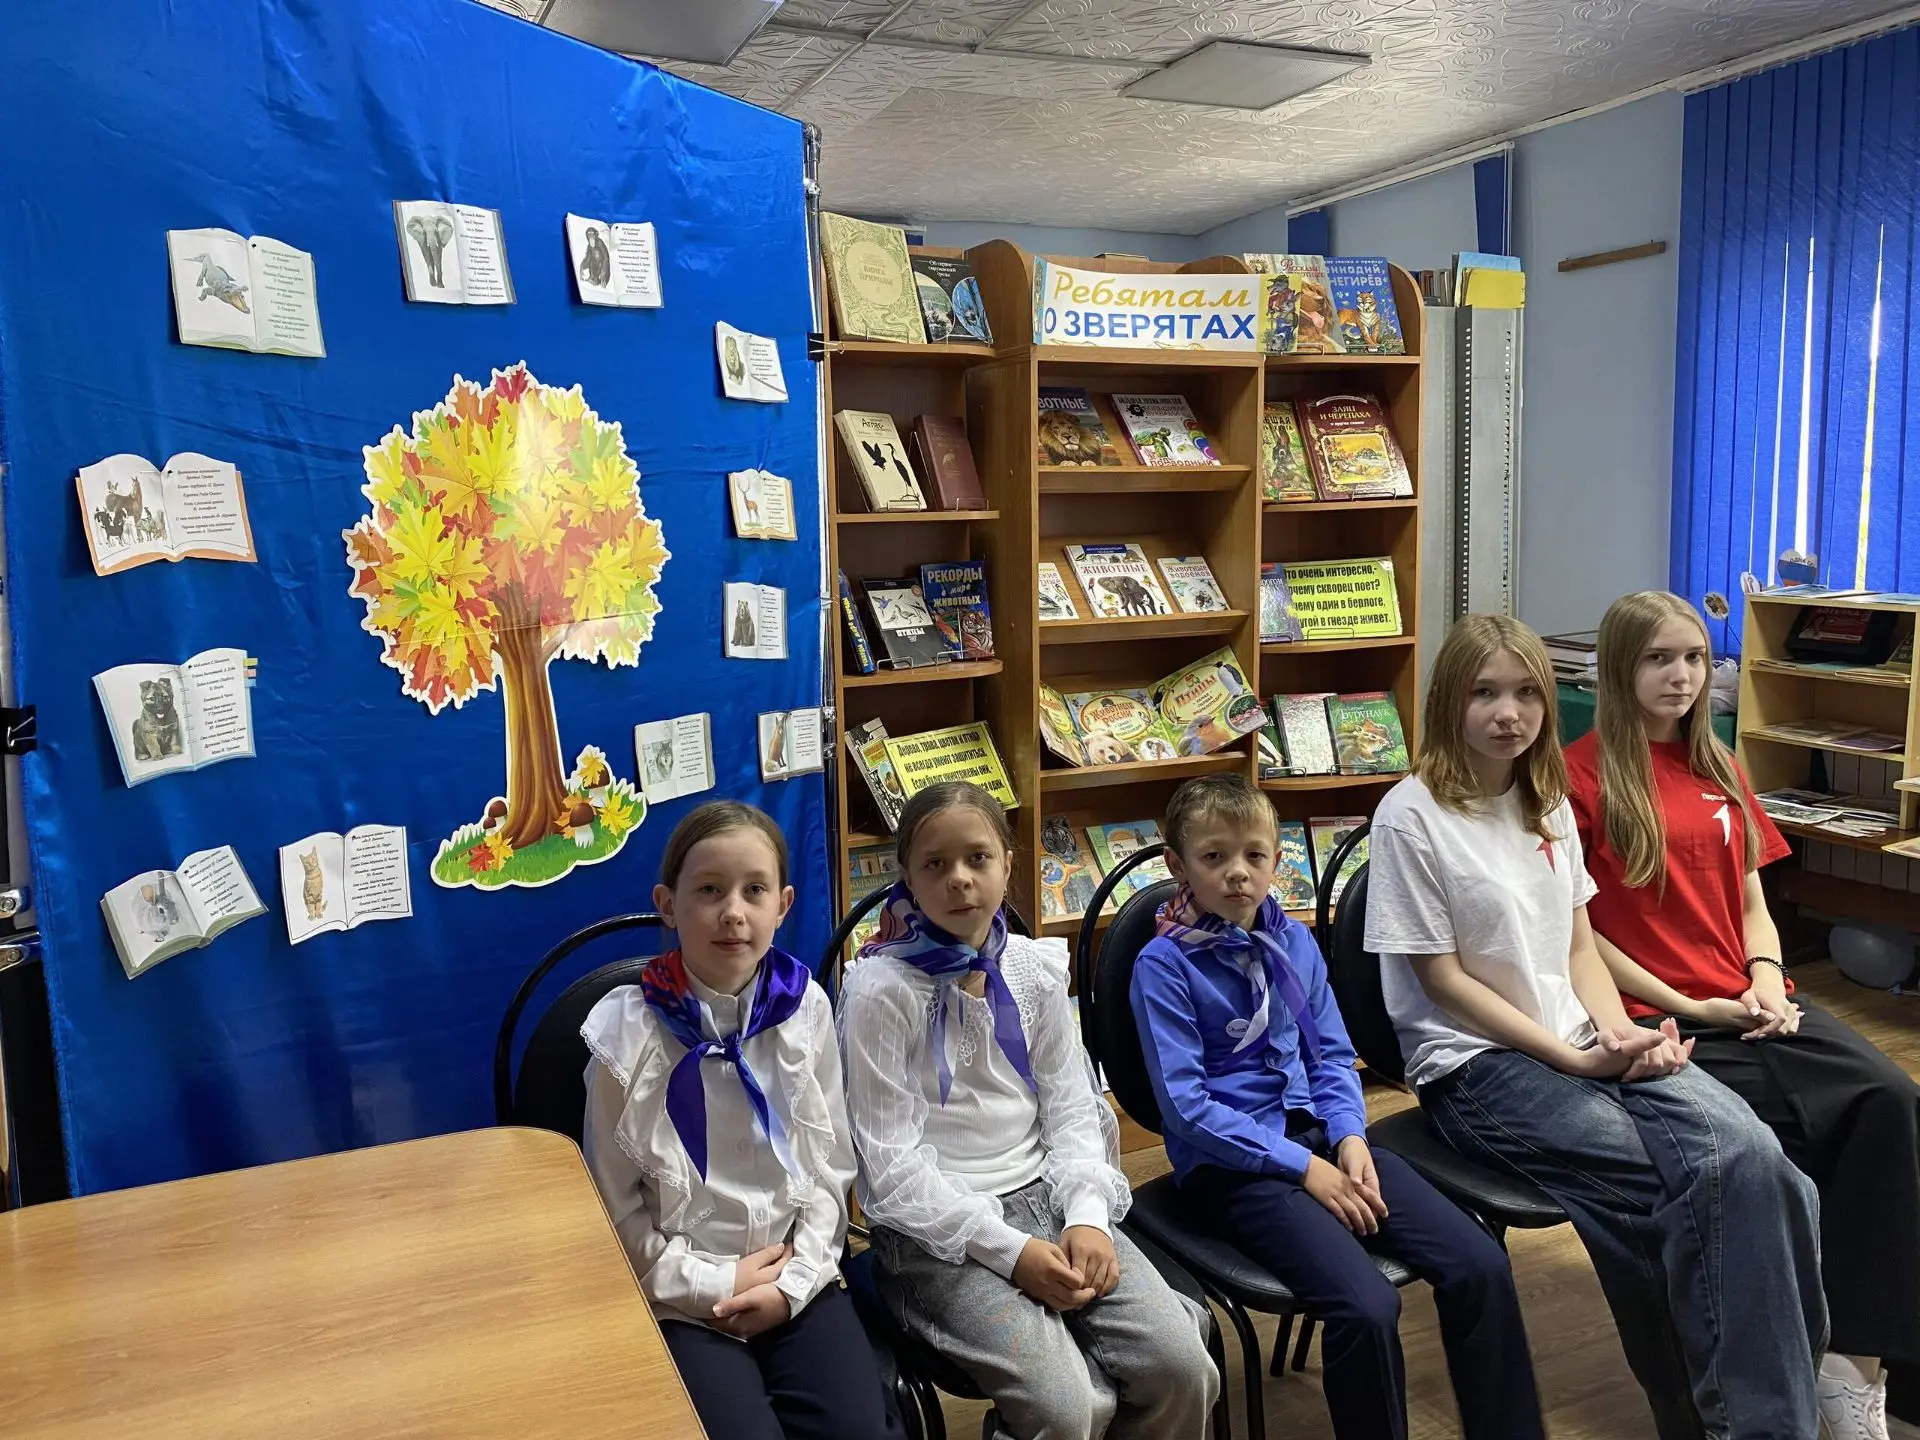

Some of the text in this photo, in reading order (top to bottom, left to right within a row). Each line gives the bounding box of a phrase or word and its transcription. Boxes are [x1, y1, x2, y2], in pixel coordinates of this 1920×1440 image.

[1330, 274, 1383, 286] НЕГИРЁВ
[1054, 271, 1251, 308] Ребятам
[1044, 307, 1256, 340] О ЗВЕРЯТАХ
[1037, 397, 1088, 410] ВОТНЫЕ
[1331, 405, 1356, 413] ЗАЯЦ
[1263, 416, 1291, 425] ЬШАЯ
[1328, 411, 1371, 420] ЧЕРЕПАХА
[927, 567, 983, 584] РЕКОРДЫ
[1080, 564, 1148, 575] ЖИВОТНЫЕ
[1298, 566, 1324, 579] очень
[1288, 579, 1380, 596] очему скворец поет?
[933, 595, 981, 608] ЖИВОТНЫХ
[1294, 601, 1315, 612] чему
[1316, 599, 1339, 611] один
[1340, 600, 1346, 609] в
[1300, 613, 1391, 628] угой в гнезде живет.
